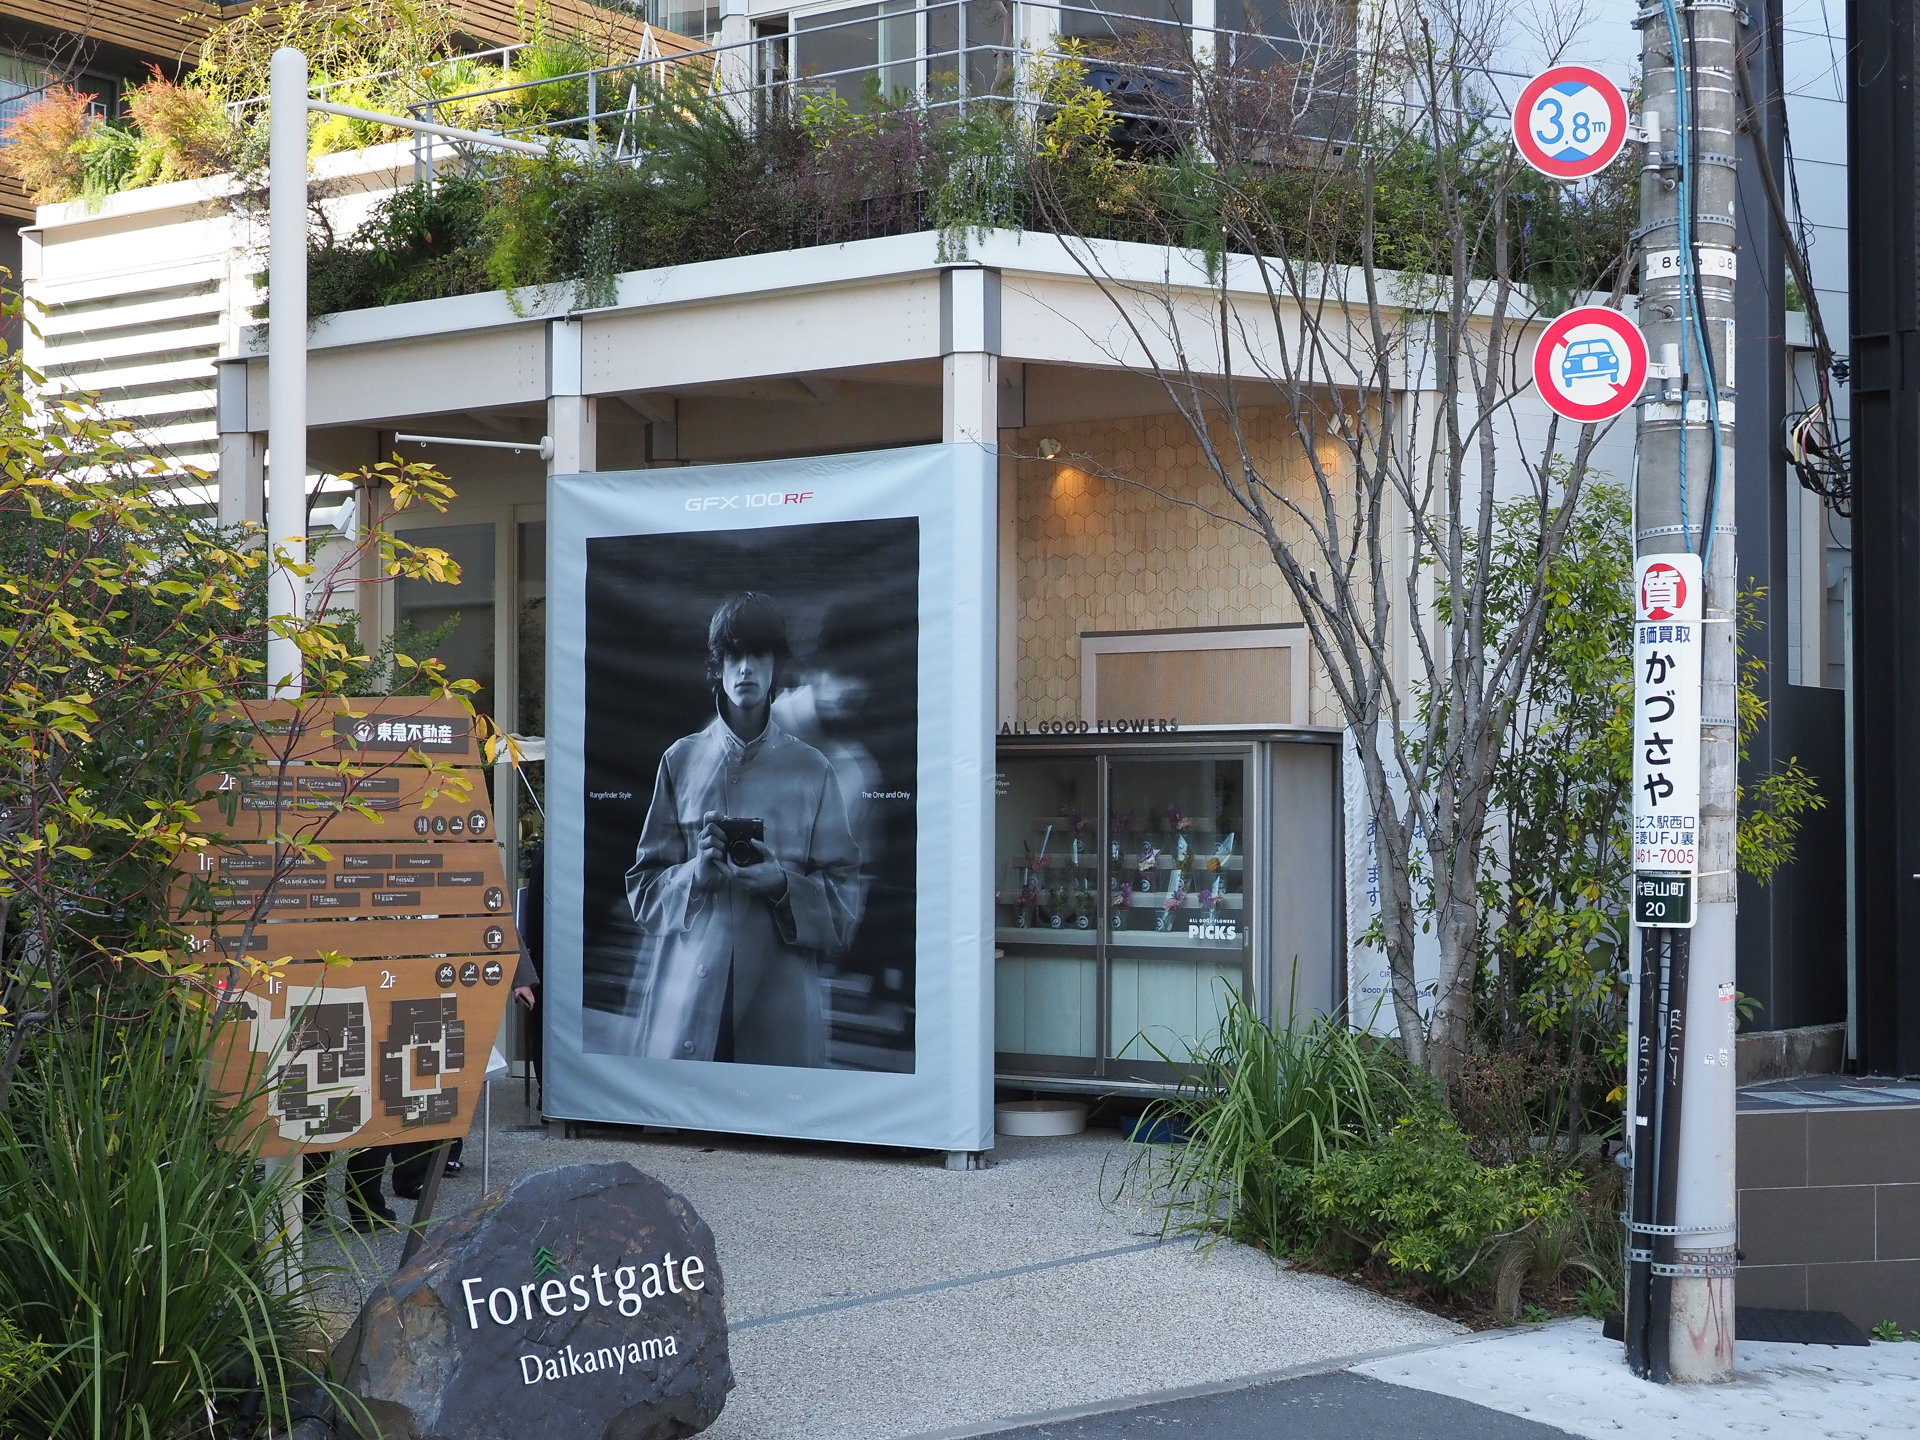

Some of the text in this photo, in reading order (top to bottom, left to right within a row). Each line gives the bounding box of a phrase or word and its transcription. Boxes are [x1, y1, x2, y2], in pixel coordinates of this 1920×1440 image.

[684, 492, 814, 512] GFX 100RF
[1643, 568, 1682, 615] 質
[377, 722, 452, 744] 東急不動産
[1000, 718, 1179, 735] ALL GOOD FLOWERS
[1643, 650, 1676, 806] かづさや
[590, 792, 632, 800] Rangefinder Style
[897, 791, 910, 800] Only
[1645, 902, 1665, 916] 20
[1188, 925, 1236, 940] PICKS
[380, 970, 396, 989] 2F
[462, 1252, 705, 1329] Forestgate
[520, 1335, 678, 1385] Daikanyama
